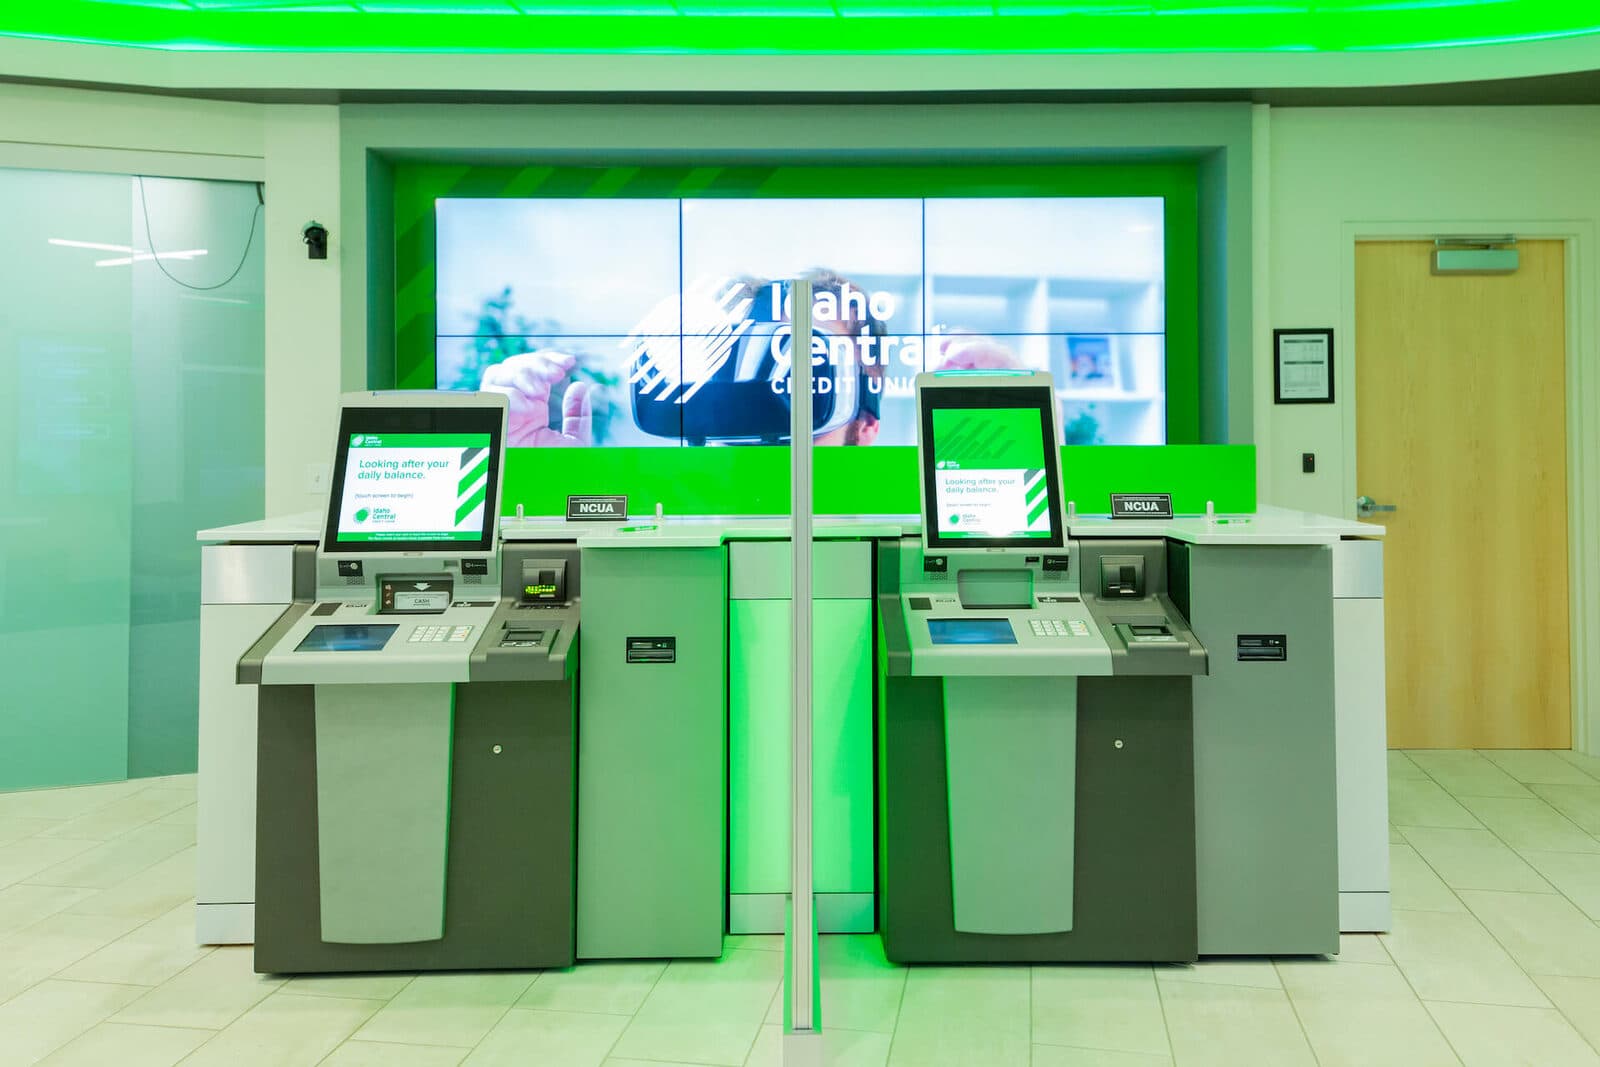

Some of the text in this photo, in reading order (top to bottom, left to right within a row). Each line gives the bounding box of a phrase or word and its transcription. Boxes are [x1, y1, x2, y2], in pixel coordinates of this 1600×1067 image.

[772, 282, 895, 321] Iaho
[771, 376, 855, 394] CDIT
[359, 459, 449, 470] Looking after your
[357, 470, 426, 481] daily balance.
[945, 478, 977, 486] Looking
[580, 503, 614, 513] NCUA
[1124, 501, 1160, 511] NCUA
